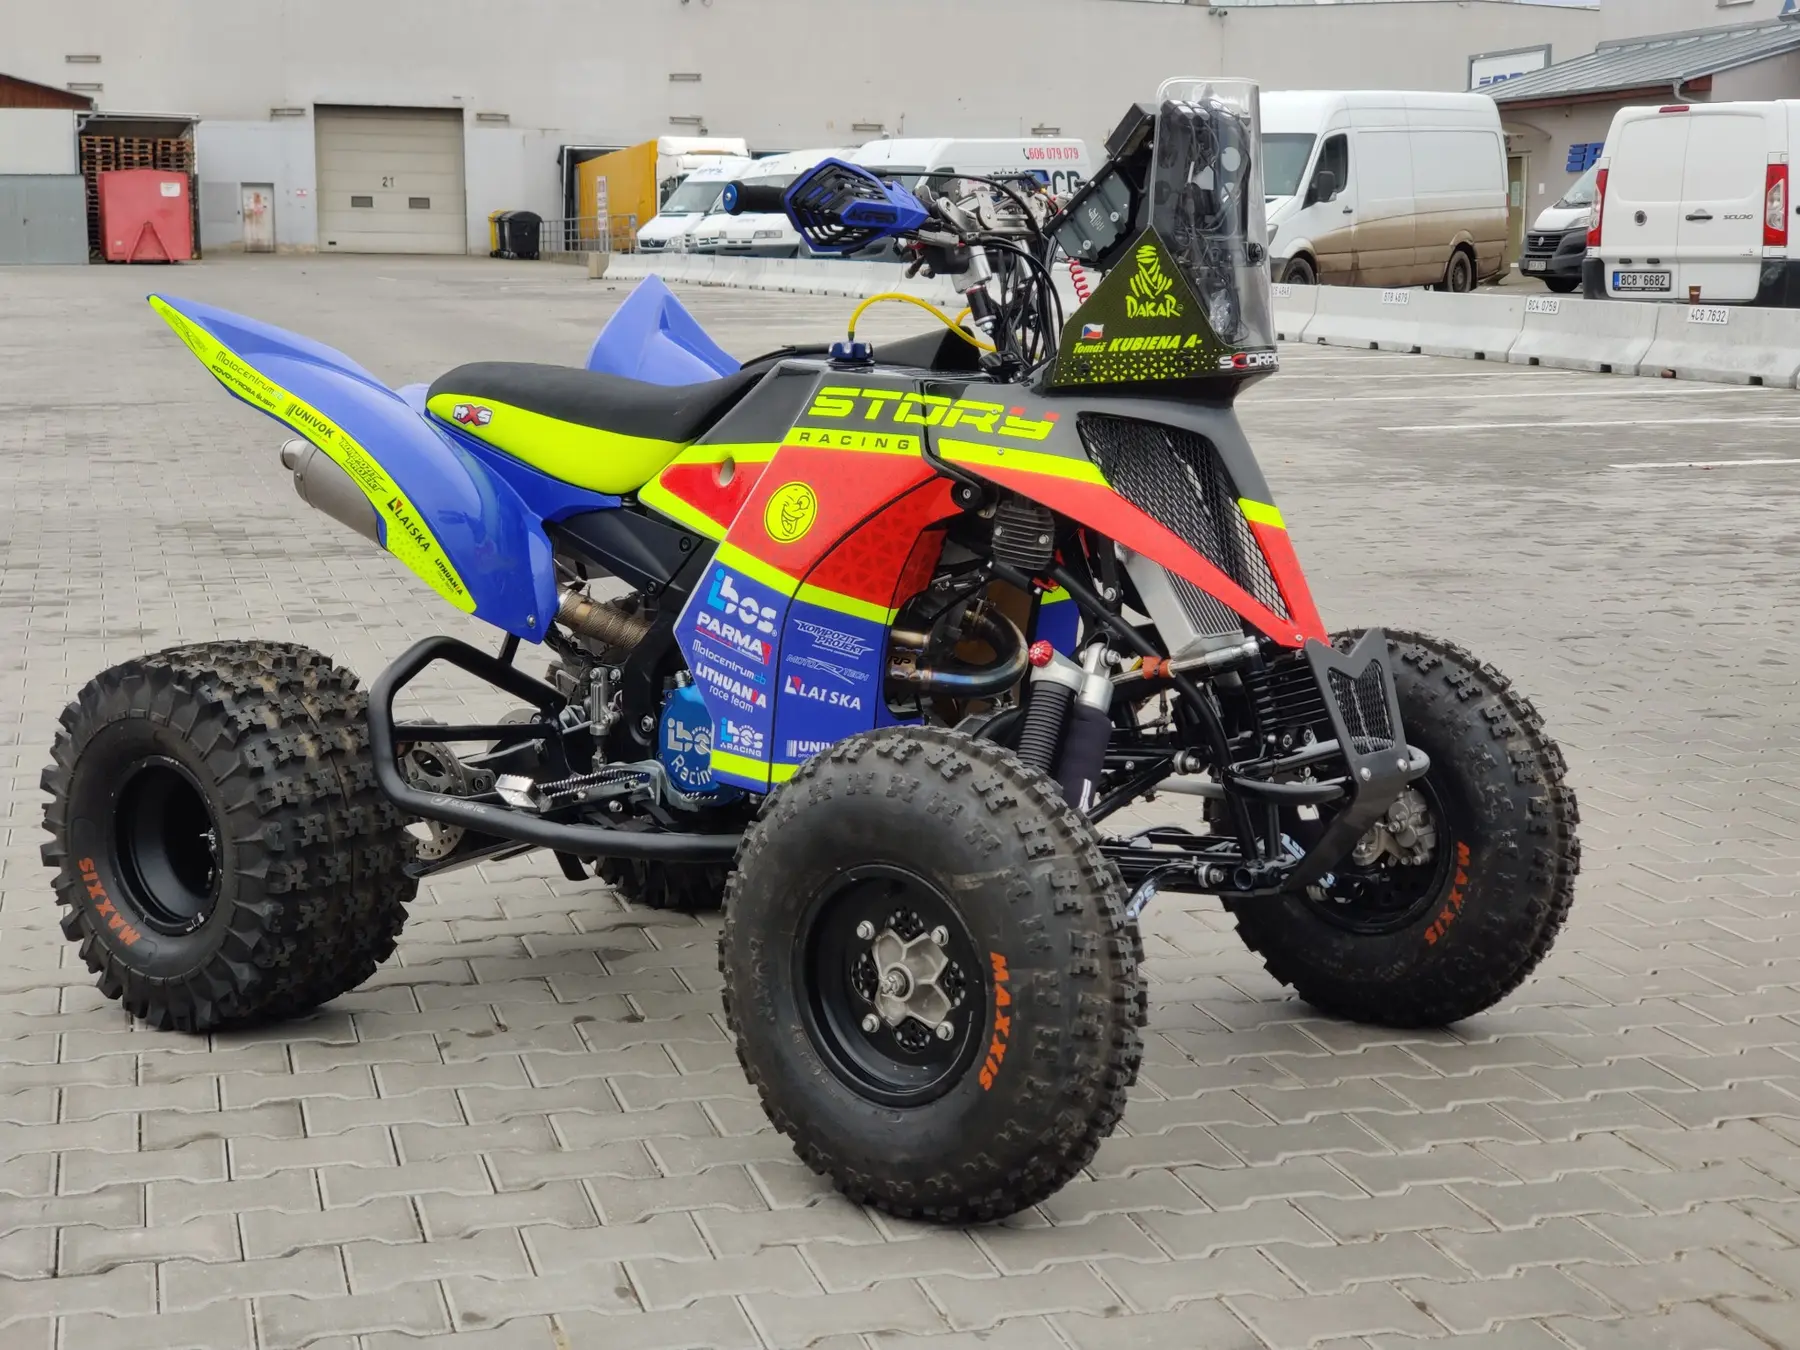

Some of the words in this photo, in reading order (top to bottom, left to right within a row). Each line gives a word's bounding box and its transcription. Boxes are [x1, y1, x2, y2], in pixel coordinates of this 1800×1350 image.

[1028, 147, 1044, 159] 606
[1046, 147, 1062, 159] 079
[1063, 147, 1079, 160] 079
[382, 176, 394, 188] 21
[1621, 274, 1637, 286] 8C8
[1643, 274, 1666, 286] 6682
[1125, 293, 1181, 318] DAKAR
[1690, 308, 1705, 321] 4C6
[1707, 309, 1727, 323] 7632
[1072, 341, 1107, 354] Tomáš
[1108, 336, 1182, 352] KUBIENA
[294, 407, 336, 439] UNIVOK
[453, 404, 493, 426] MXS
[807, 386, 1060, 441] STORY
[799, 431, 910, 450] RACING
[394, 508, 431, 552] LAISKA
[434, 558, 463, 596] LITHUANIA
[696, 611, 764, 656] PARMA
[799, 622, 857, 645] KOMPOZIT
[815, 635, 864, 656] PROJEKT
[695, 661, 767, 709] LITHUANIA
[709, 684, 729, 701] race
[731, 693, 754, 713] team
[726, 743, 762, 757] RACING
[78, 857, 141, 947] MAXXIS
[1423, 841, 1471, 946] MAXXIS
[978, 951, 1012, 1092] MAXXIS
